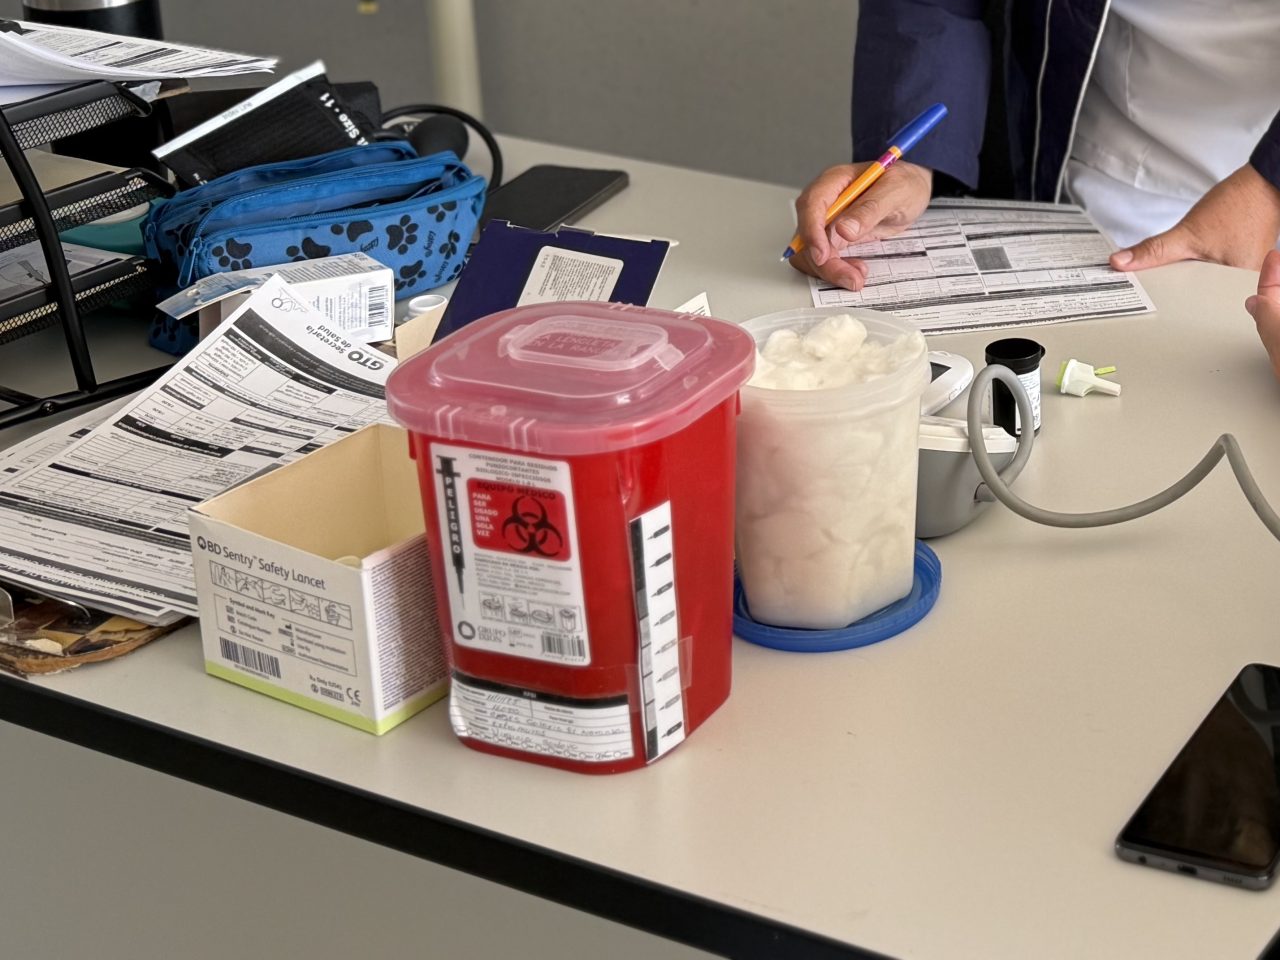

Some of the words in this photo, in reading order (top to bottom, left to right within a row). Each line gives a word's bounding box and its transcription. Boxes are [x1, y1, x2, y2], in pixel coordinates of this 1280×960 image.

[339, 113, 360, 140] Size
[306, 325, 346, 354] Secretaría
[317, 325, 342, 342] Salud
[341, 340, 352, 349] de
[347, 351, 385, 371] GTO
[445, 476, 462, 554] PELIGRO
[206, 541, 222, 556] BD
[259, 558, 290, 582] Safety
[292, 569, 327, 590] Lancet
